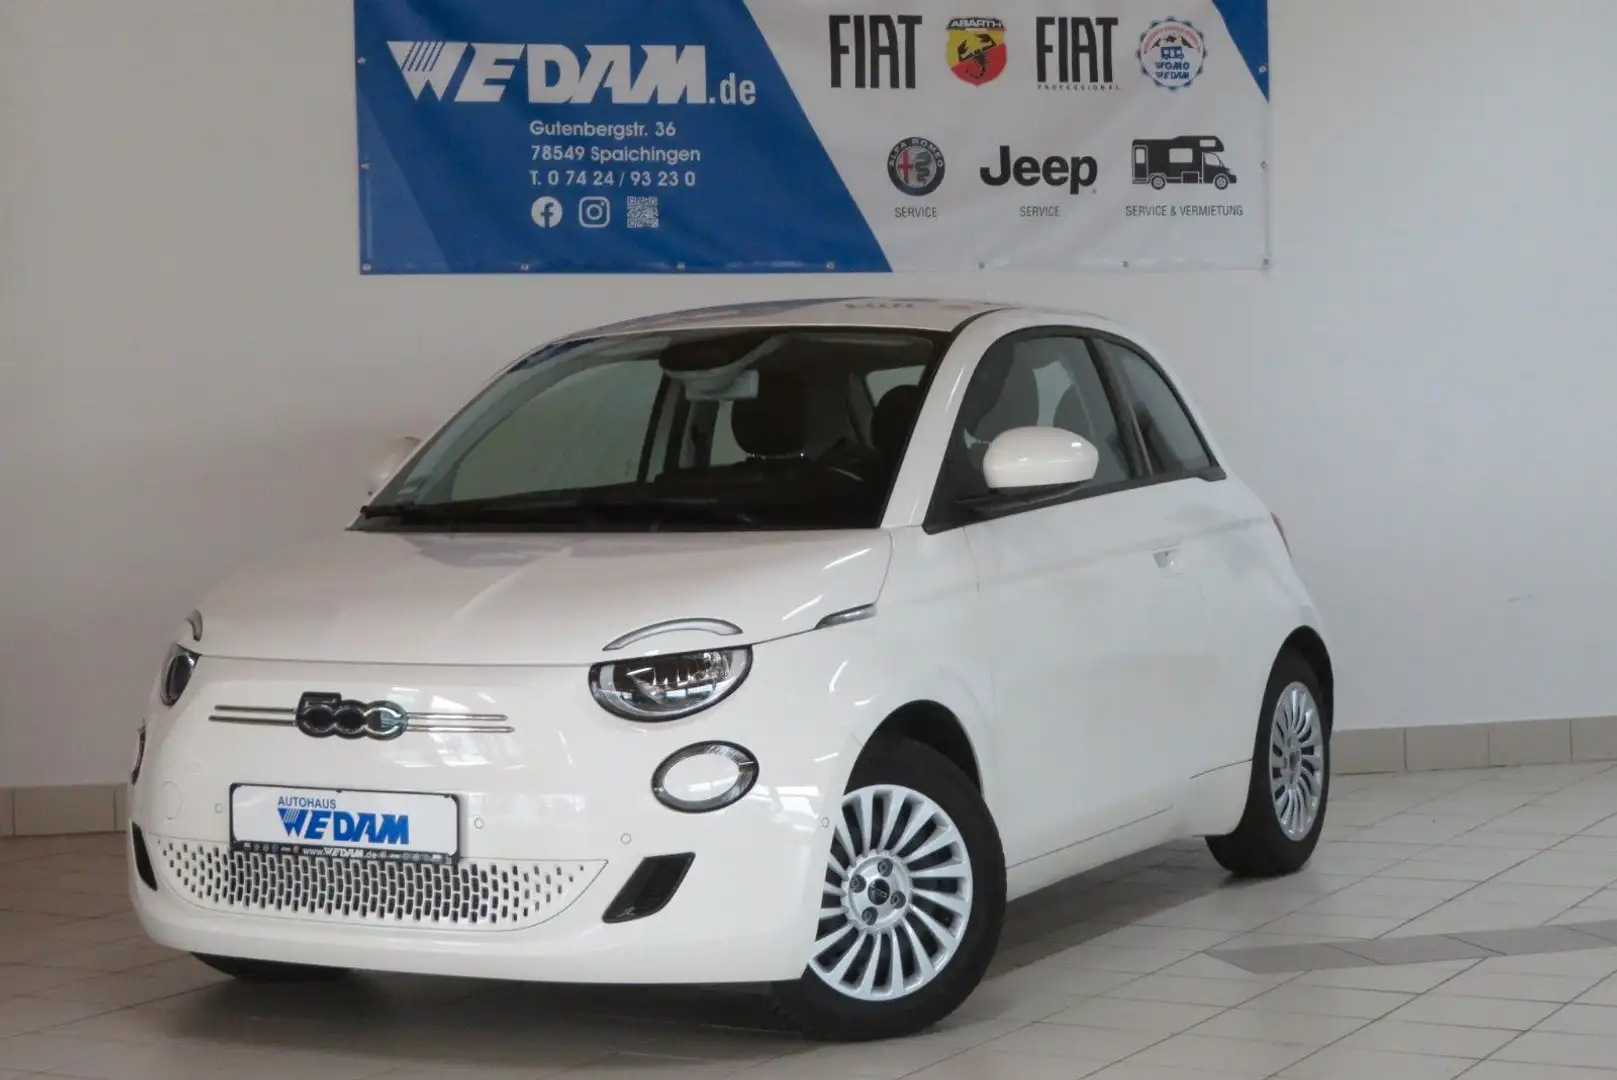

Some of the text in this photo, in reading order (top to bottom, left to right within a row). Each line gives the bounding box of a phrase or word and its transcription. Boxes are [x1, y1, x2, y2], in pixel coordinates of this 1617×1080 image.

[950, 19, 1002, 28] ABARTH
[829, 15, 922, 89] FIAT
[1036, 17, 1119, 83] FIAT
[529, 121, 676, 140] Gutenbergstr. 36
[531, 145, 701, 166] 78549 Spaichingen
[530, 171, 541, 186] T.
[548, 171, 559, 186] 0
[566, 171, 588, 186] 74
[593, 171, 614, 186] 24
[630, 171, 652, 186] 93
[657, 171, 679, 186] 23
[685, 171, 696, 186] 0
[980, 145, 1098, 195] Jeep
[894, 206, 938, 218] SERVICE
[1019, 205, 1060, 217] SERVICE
[1125, 205, 1244, 217] SERVICE & VERMIETUNG
[277, 796, 337, 809] AUTOHAUS
[277, 808, 410, 845] WEDAM
